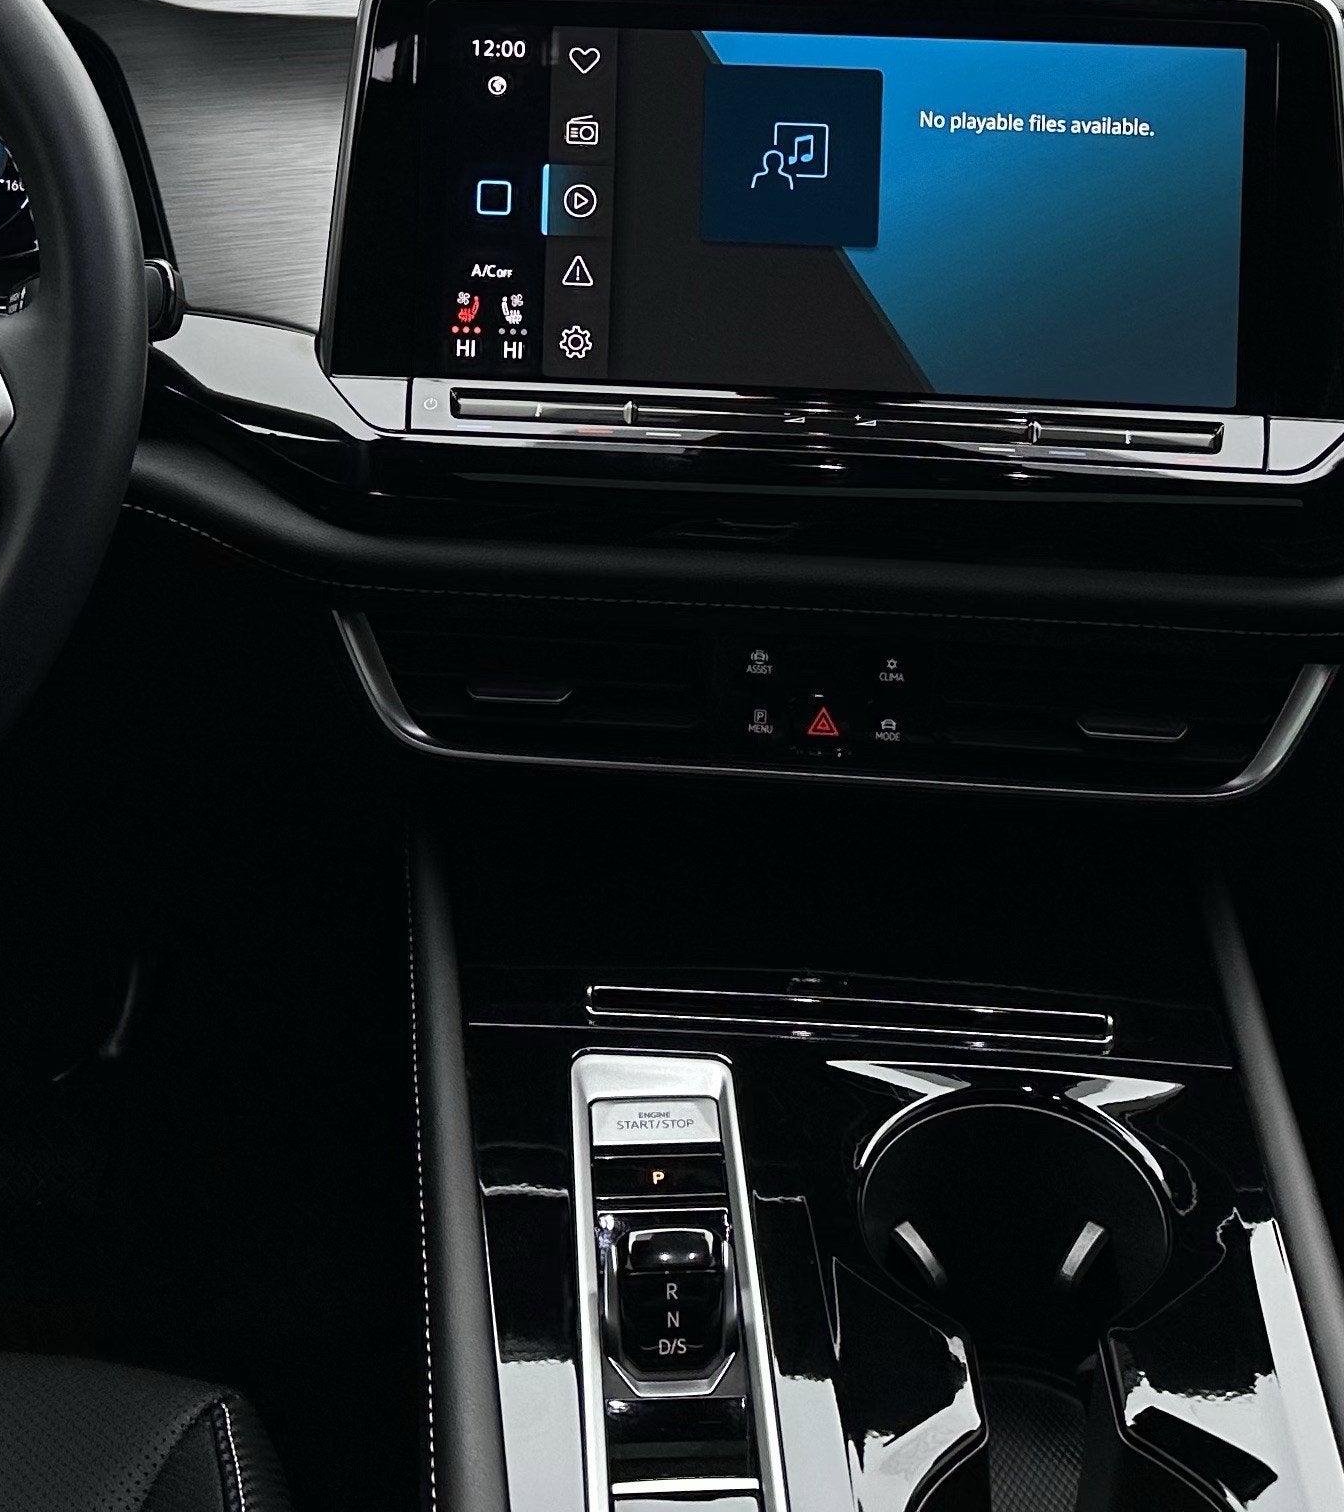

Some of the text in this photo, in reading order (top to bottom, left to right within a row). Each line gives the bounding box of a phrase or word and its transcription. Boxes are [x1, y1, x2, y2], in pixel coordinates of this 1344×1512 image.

[472, 39, 526, 58] 12:00
[919, 110, 1155, 137] No playable files available.
[456, 339, 523, 360] HI HI
[746, 664, 773, 675] ASSIST
[879, 672, 905, 682] CLIMA
[748, 724, 773, 734] MENU
[875, 732, 901, 742] MODE
[638, 1111, 671, 1119] ENGINE
[616, 1119, 694, 1130] START/STOP
[652, 1171, 665, 1185] P
[666, 1283, 679, 1301] R
[667, 1311, 680, 1328] N
[658, 1339, 687, 1355] D/S
